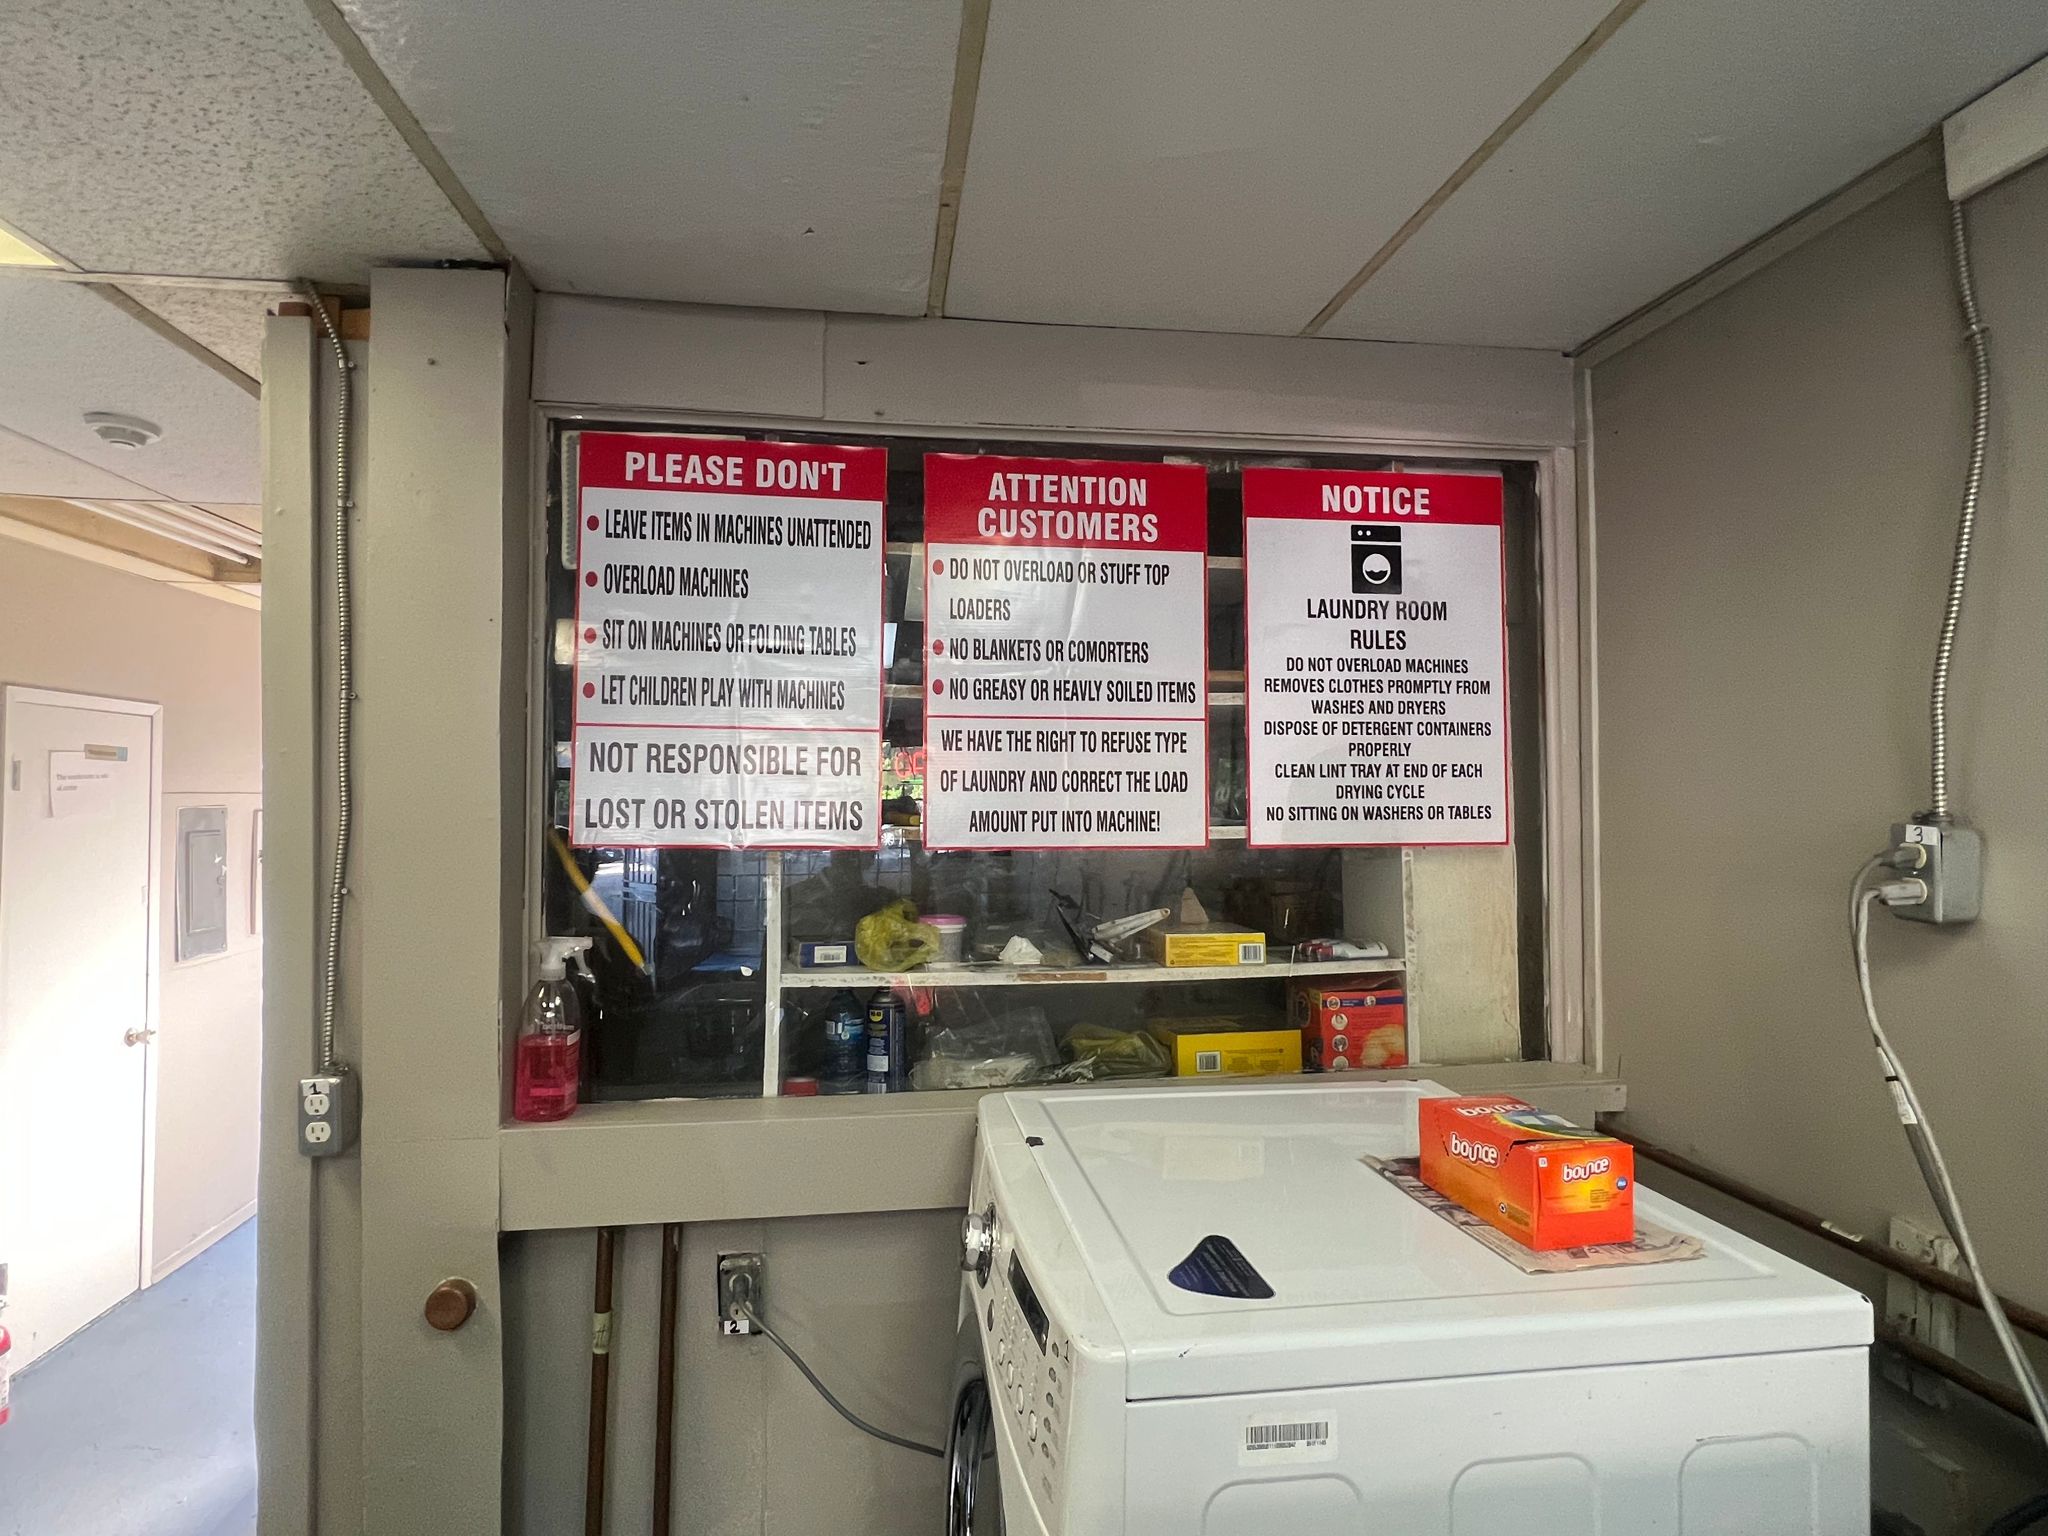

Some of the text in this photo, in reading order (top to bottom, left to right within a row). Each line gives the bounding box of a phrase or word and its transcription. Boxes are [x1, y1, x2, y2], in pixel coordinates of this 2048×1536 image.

[625, 452, 846, 491] PLEASE DON'T
[988, 472, 1147, 506] ATTENTION
[1322, 484, 1429, 516] NOTICE
[606, 509, 871, 549] LEAVE ITEMS IN MACHINES UNATTENDED
[978, 508, 1158, 542] CUSTOMERS
[604, 563, 749, 598] OVERLOAD MACHINES
[950, 558, 1169, 586] DO NOT OVERLOAD OR STUFF TOP
[950, 598, 1010, 621] LOADERS
[1307, 599, 1447, 621] LAUNDRY ROOM
[602, 619, 856, 657] SIT ON MACHINES OR FOLDING TABLES
[1350, 630, 1406, 650] RULES
[950, 638, 1149, 663] NO BLANKETS OR COMORTERS
[1287, 657, 1468, 673] DO NOT OVERLOAD MACHINES
[601, 675, 844, 710] LET CHILDREN PLAY WITH MACHINES
[950, 678, 1196, 703] NO GREASY OR HEAVLY SOILED ITEMS
[1264, 678, 1490, 694] REMOVES CLOTHES PROMPTLY FROM
[1312, 700, 1445, 715] WASHES AND DRYERS
[1264, 721, 1491, 736] DISPOSE OF DETERGENT CONTAINERS
[941, 730, 1187, 753] WE HAVE THE RIGHT TO REFUSE TYPE
[1349, 743, 1411, 757] PROPERLY
[590, 742, 861, 776] NOT RESPONSIBLE FOR
[940, 770, 1188, 792] OF LAUNDRY AND CORRECT THE LOAD
[1275, 764, 1482, 778] CLEAN LINT TRAY AT END OF EACH
[1336, 785, 1425, 799] DRYING CYCLE
[585, 798, 863, 830] LOST OR STOLEN ITEMS
[970, 810, 1160, 832] AMOUNT PUT INTO MACHINE!
[1266, 805, 1491, 821] NO SITTING ON WASHERS OR TABLES
[1914, 827, 1923, 842] 3
[310, 1083, 321, 1094] 1
[1451, 1133, 1498, 1165] bounce
[1563, 1158, 1609, 1182] bounce
[730, 1321, 740, 1333] 2
